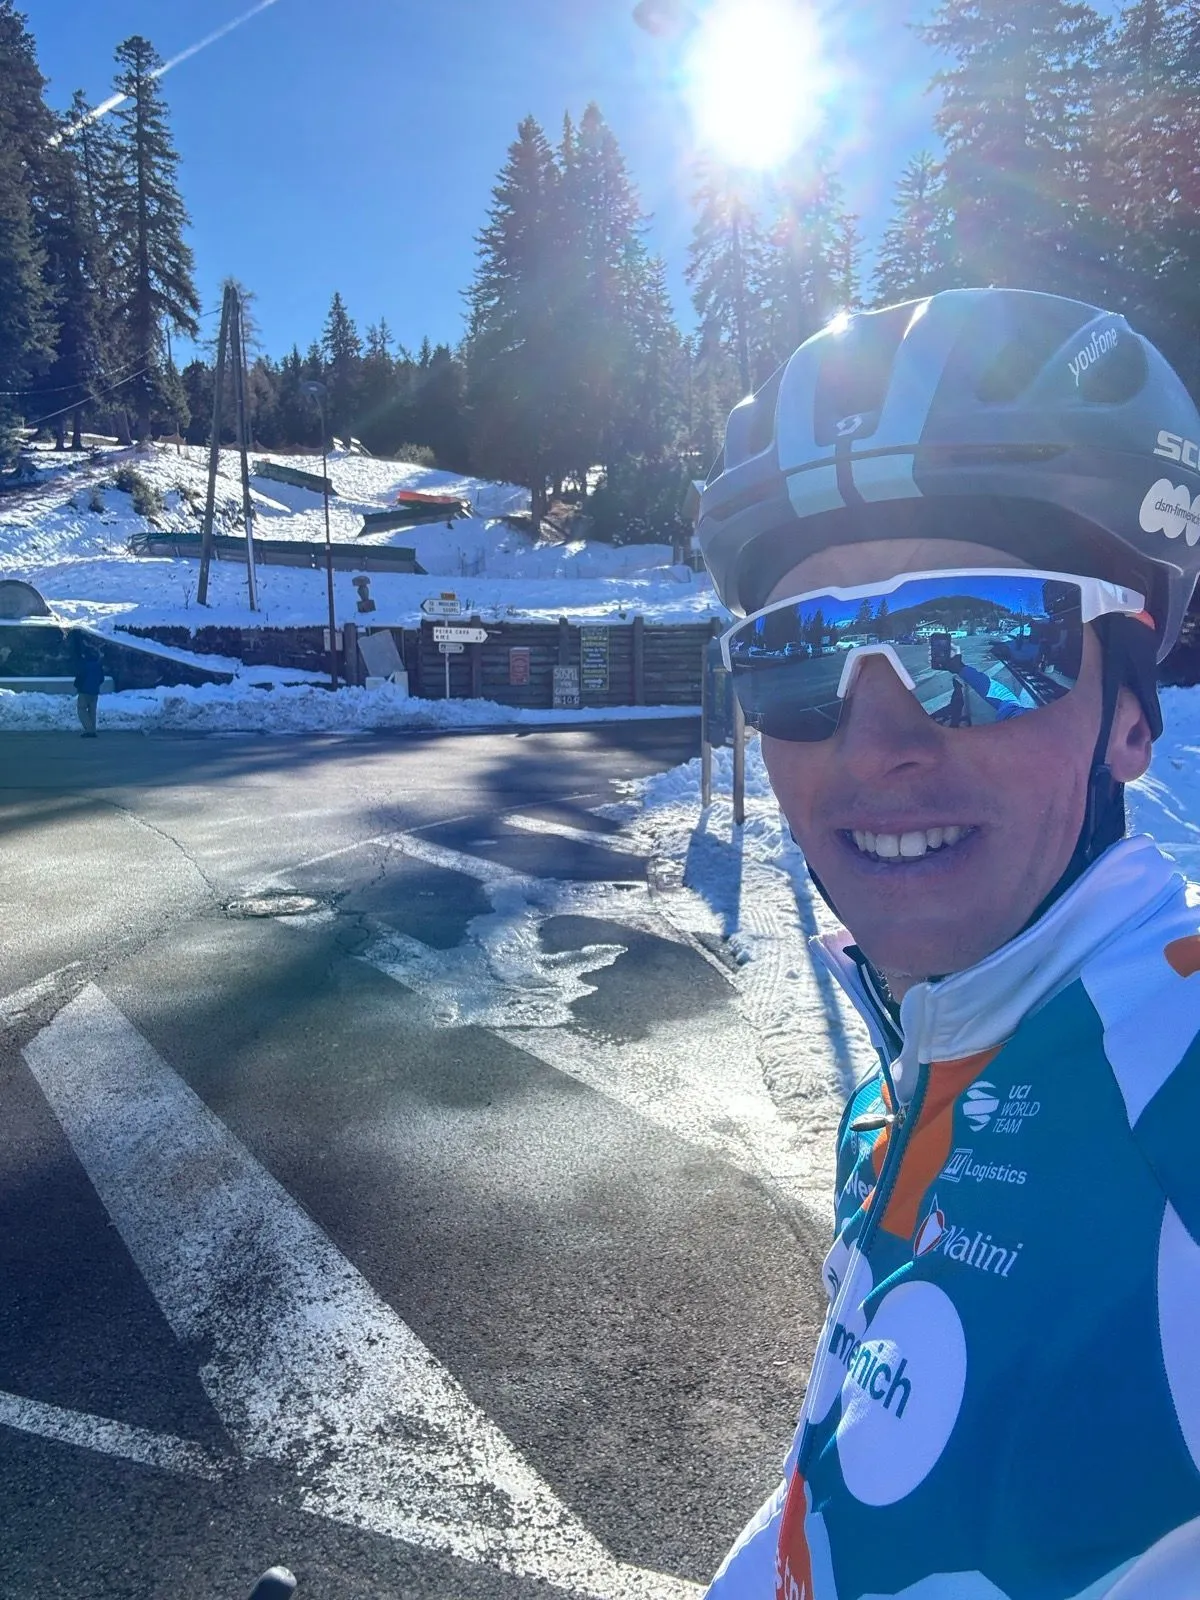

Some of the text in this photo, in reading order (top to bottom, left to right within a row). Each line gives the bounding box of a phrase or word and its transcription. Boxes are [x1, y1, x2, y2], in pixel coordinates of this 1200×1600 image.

[1068, 327, 1118, 387] youfone
[1153, 430, 1200, 471] SC
[1008, 1085, 1032, 1100] UCI
[1001, 1102, 1041, 1117] WORLD
[992, 1118, 1023, 1134] TEAM
[965, 1158, 1028, 1185] Logistics
[933, 1224, 1024, 1278] Nalini
